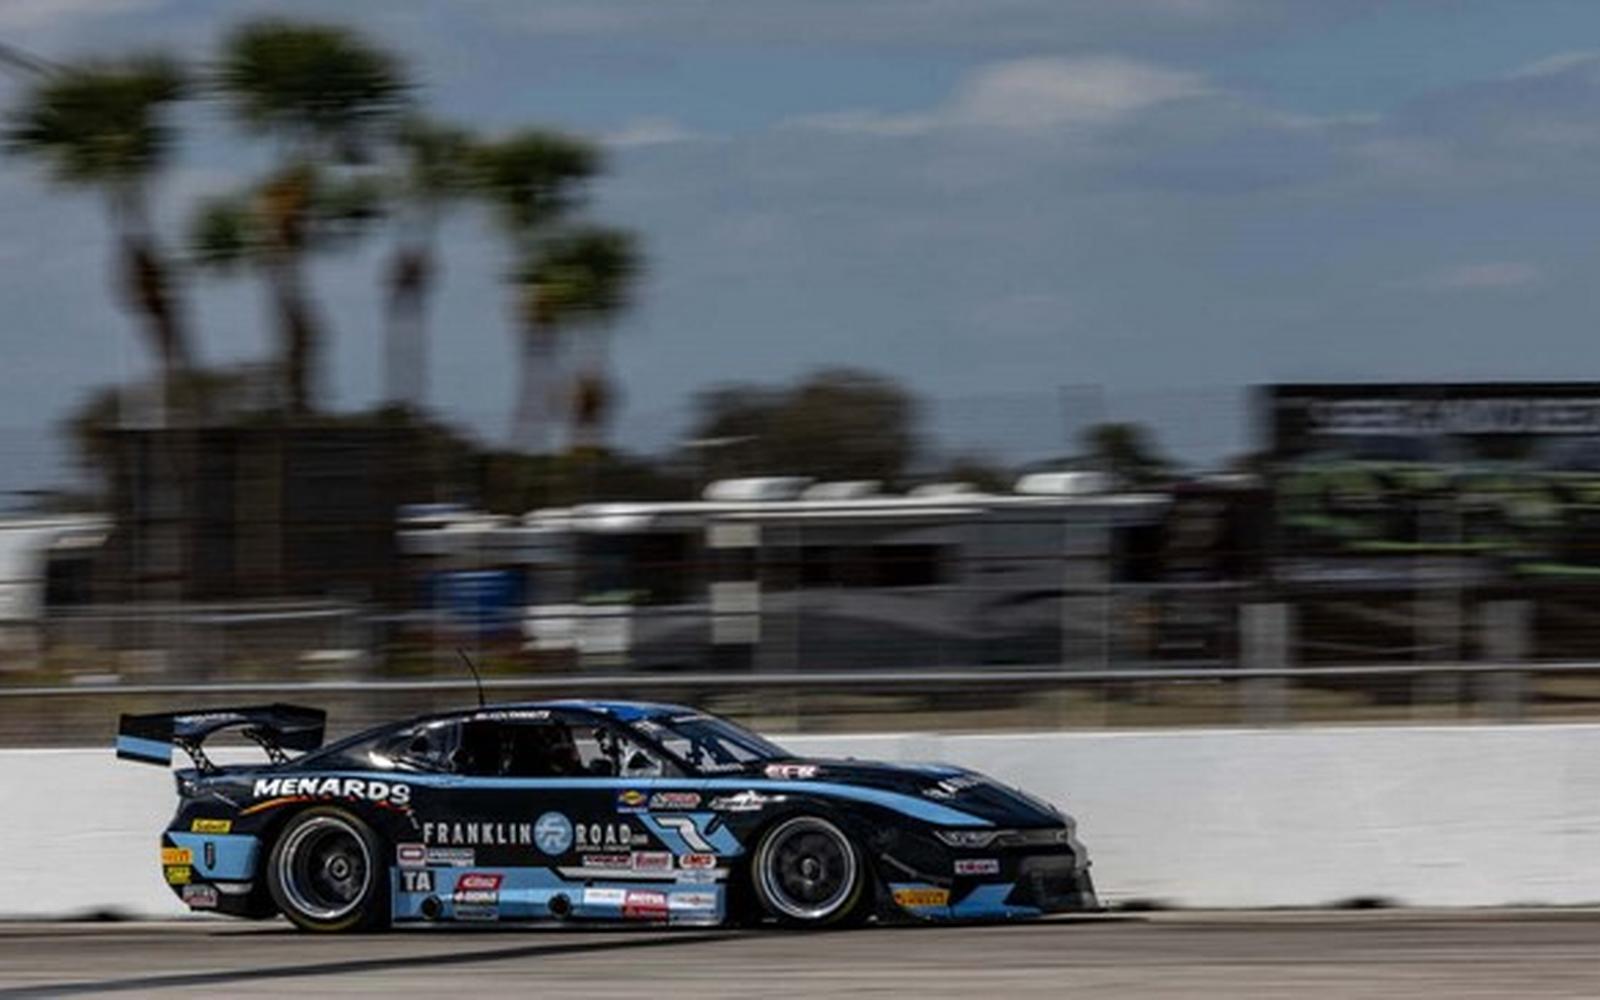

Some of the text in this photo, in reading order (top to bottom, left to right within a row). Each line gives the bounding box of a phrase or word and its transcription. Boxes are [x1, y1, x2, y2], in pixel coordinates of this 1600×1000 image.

[253, 777, 411, 805] MENARDS
[423, 823, 532, 844] FRANKLIN
[575, 823, 631, 844] ROAD
[402, 871, 432, 891] TA
